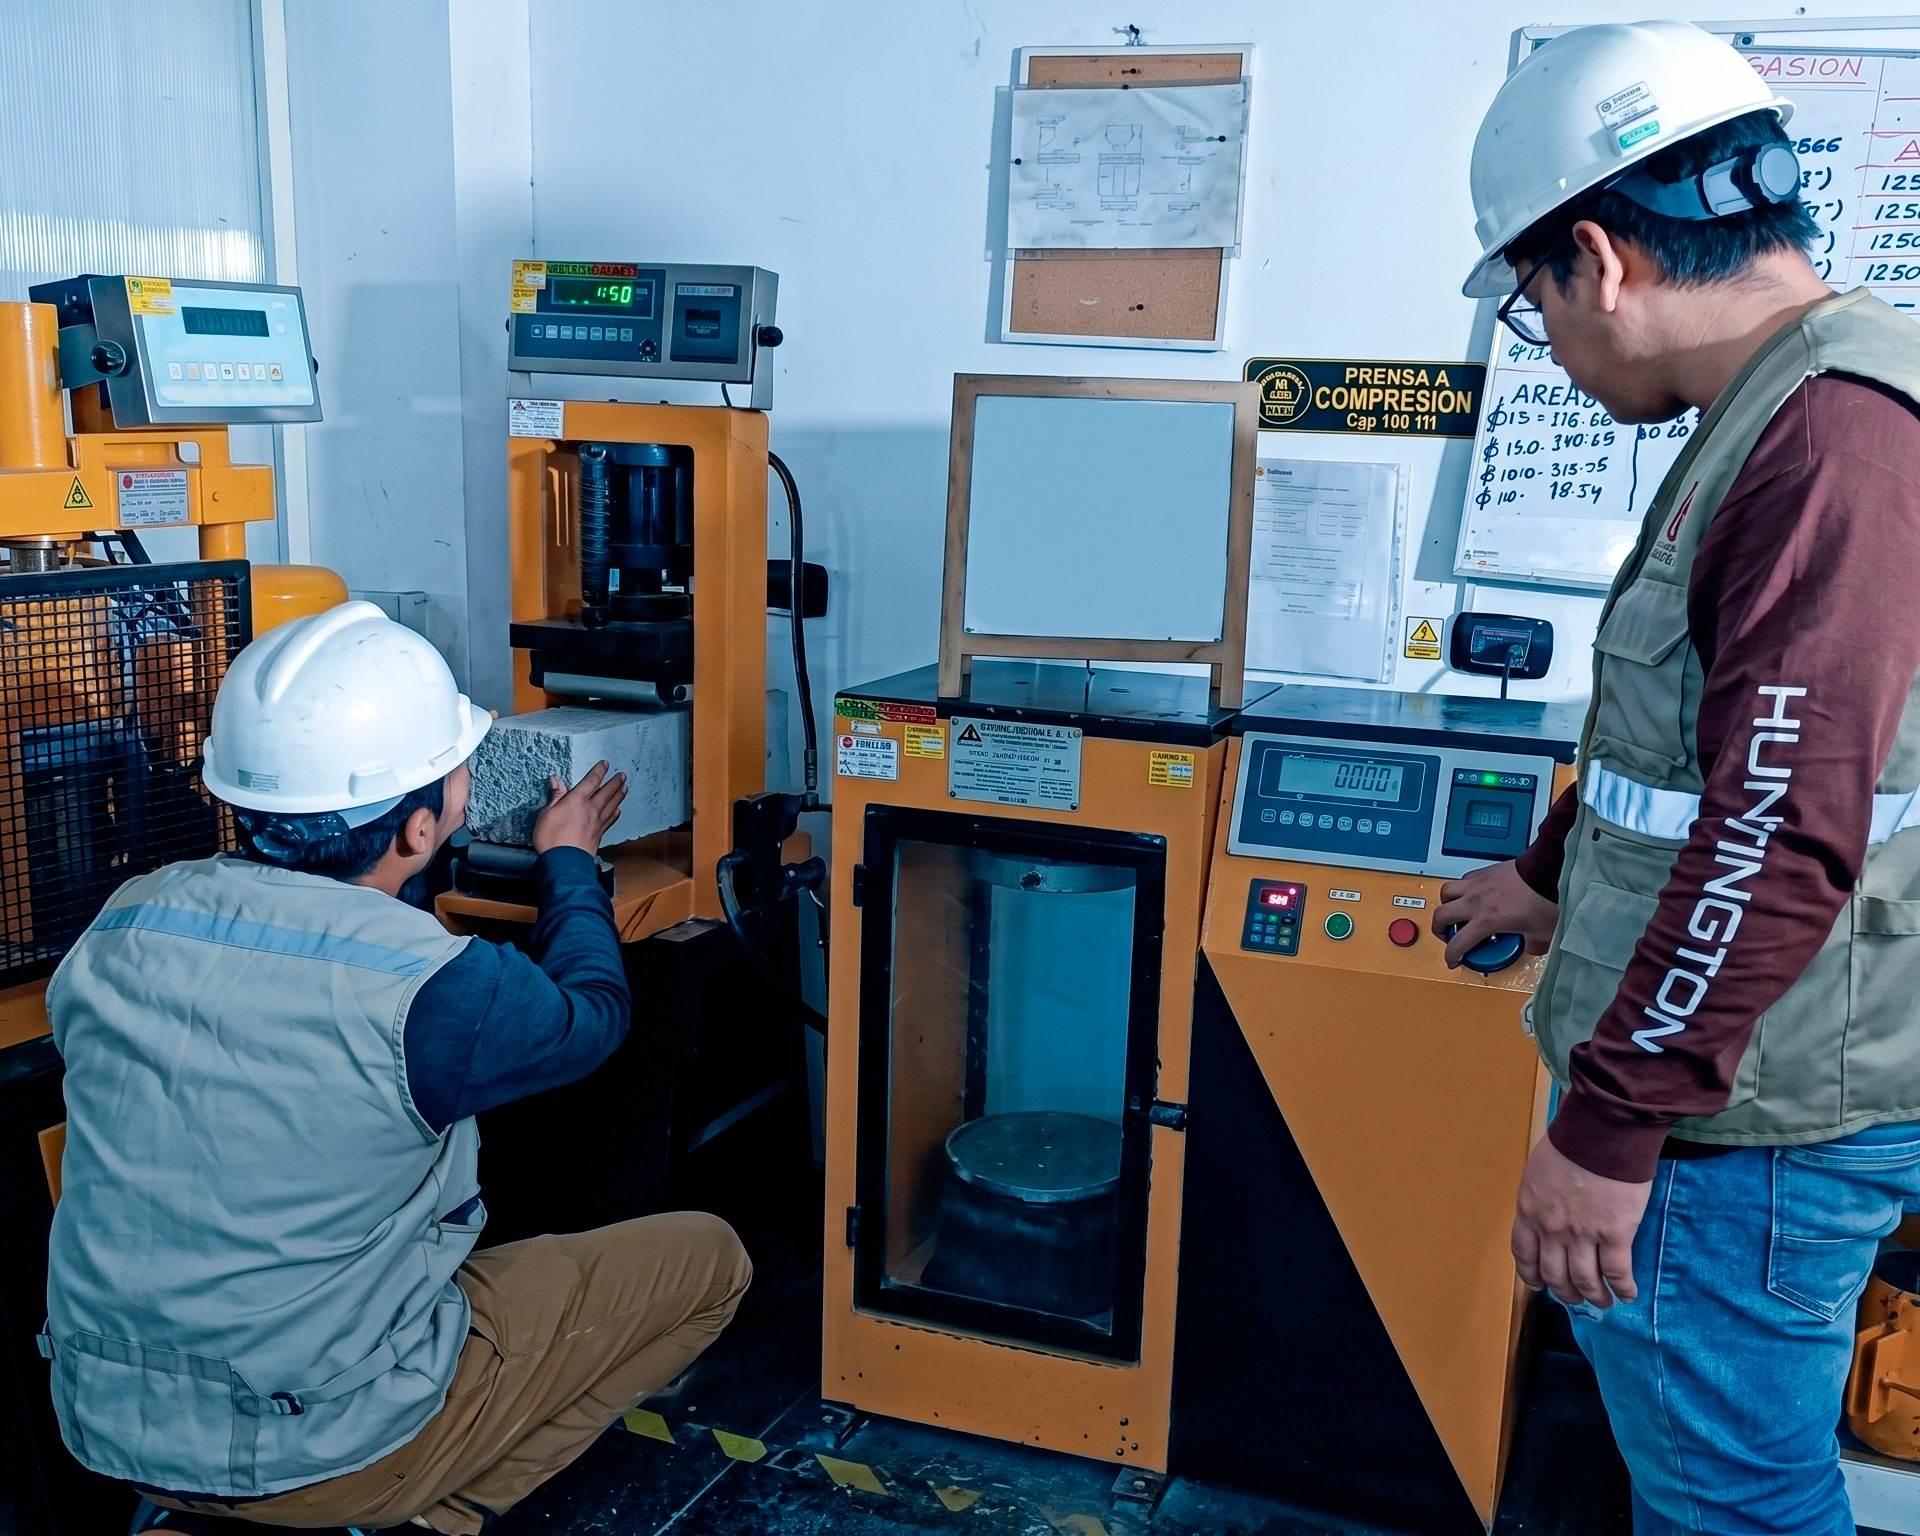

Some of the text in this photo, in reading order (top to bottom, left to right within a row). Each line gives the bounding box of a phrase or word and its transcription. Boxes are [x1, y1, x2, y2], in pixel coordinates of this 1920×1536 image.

[1345, 367, 1450, 387] PRENSA A
[1315, 386, 1472, 414] COMPRESION
[1346, 413, 1377, 431] Cap
[1382, 413, 1410, 430] 100
[1334, 763, 1392, 792] 0000
[1631, 685, 1808, 1054] HUNTINGTON
